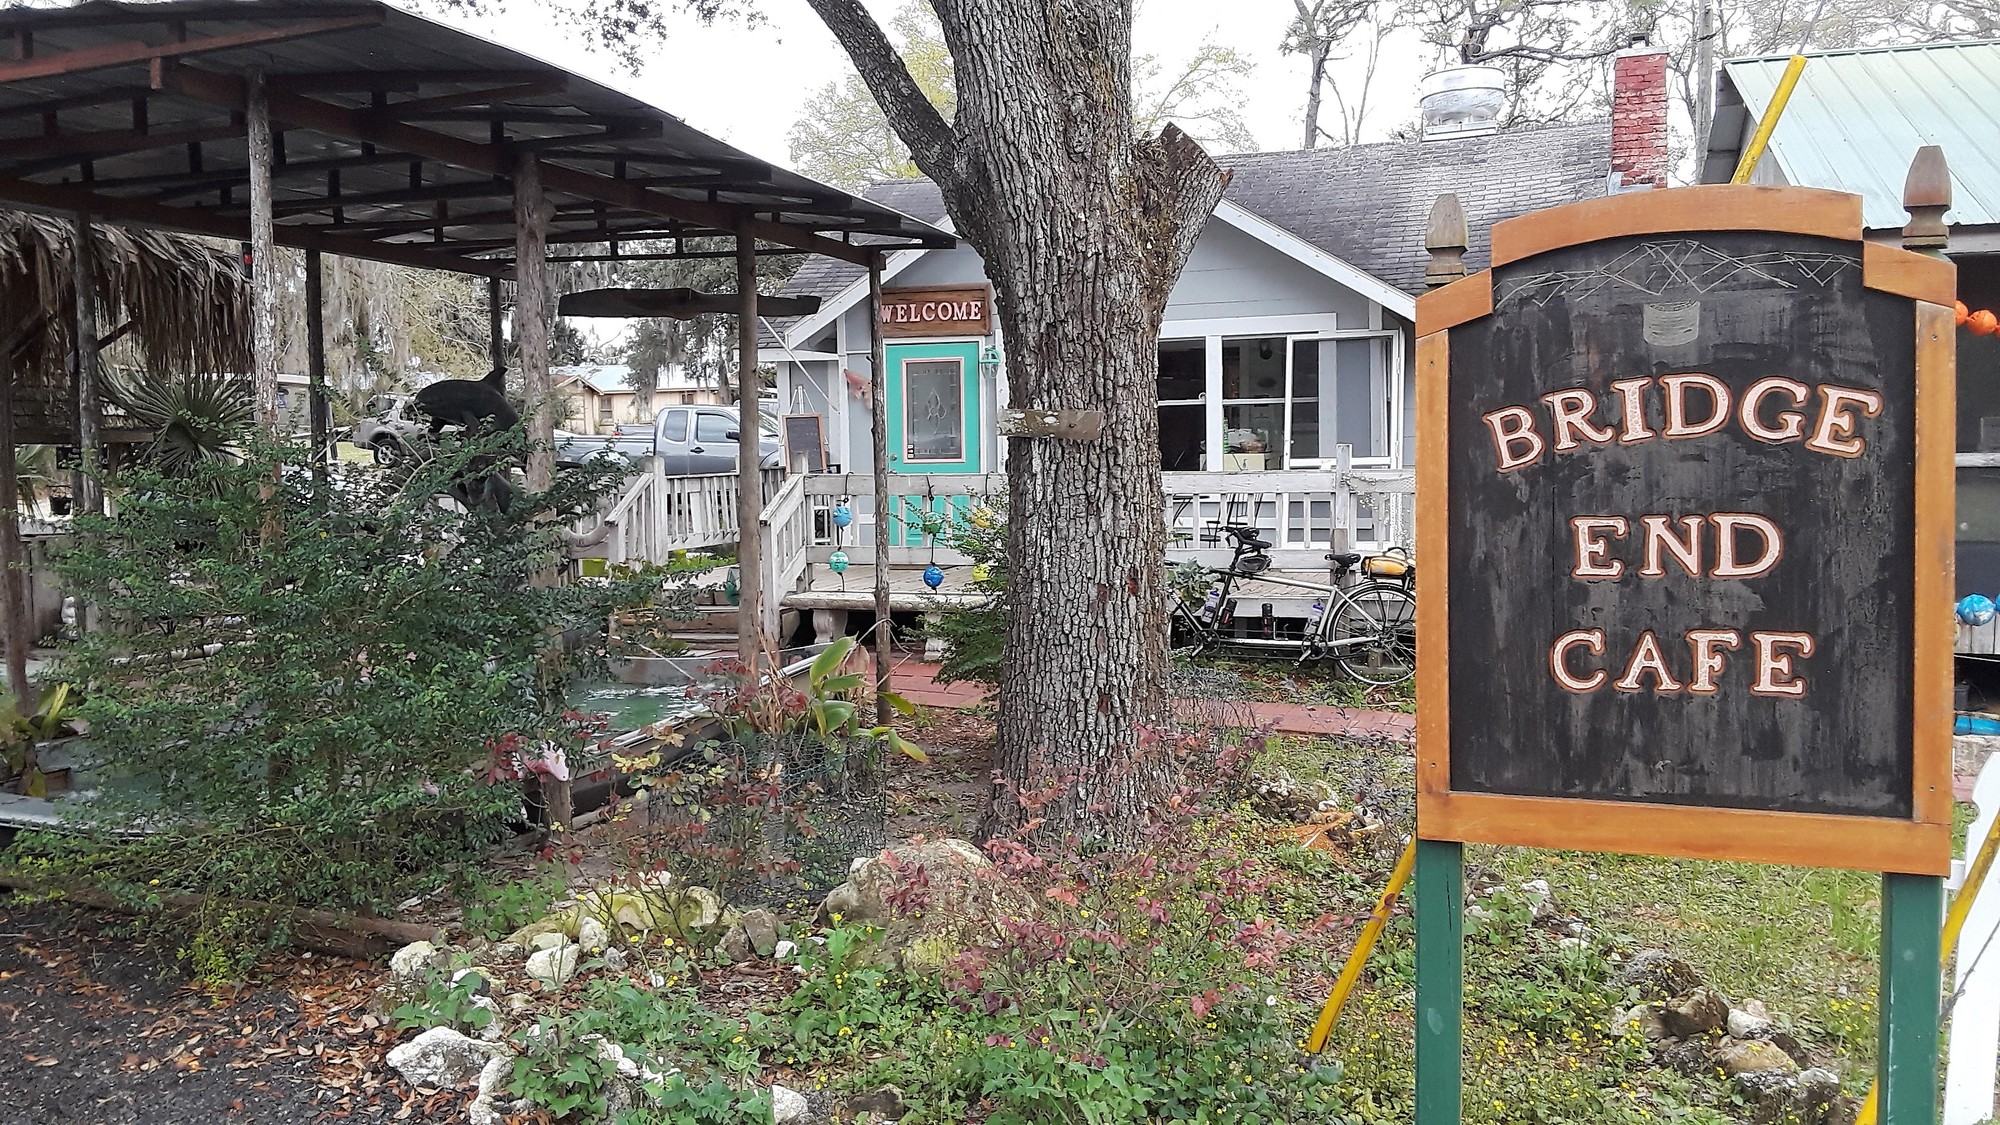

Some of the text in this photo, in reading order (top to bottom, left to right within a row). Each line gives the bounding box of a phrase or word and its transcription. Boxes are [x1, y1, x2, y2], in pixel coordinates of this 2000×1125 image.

[881, 302, 981, 322] WELCOME
[1483, 374, 1882, 473] BRIDGE
[1571, 513, 1782, 579] END
[1550, 629, 1815, 696] CAFE
